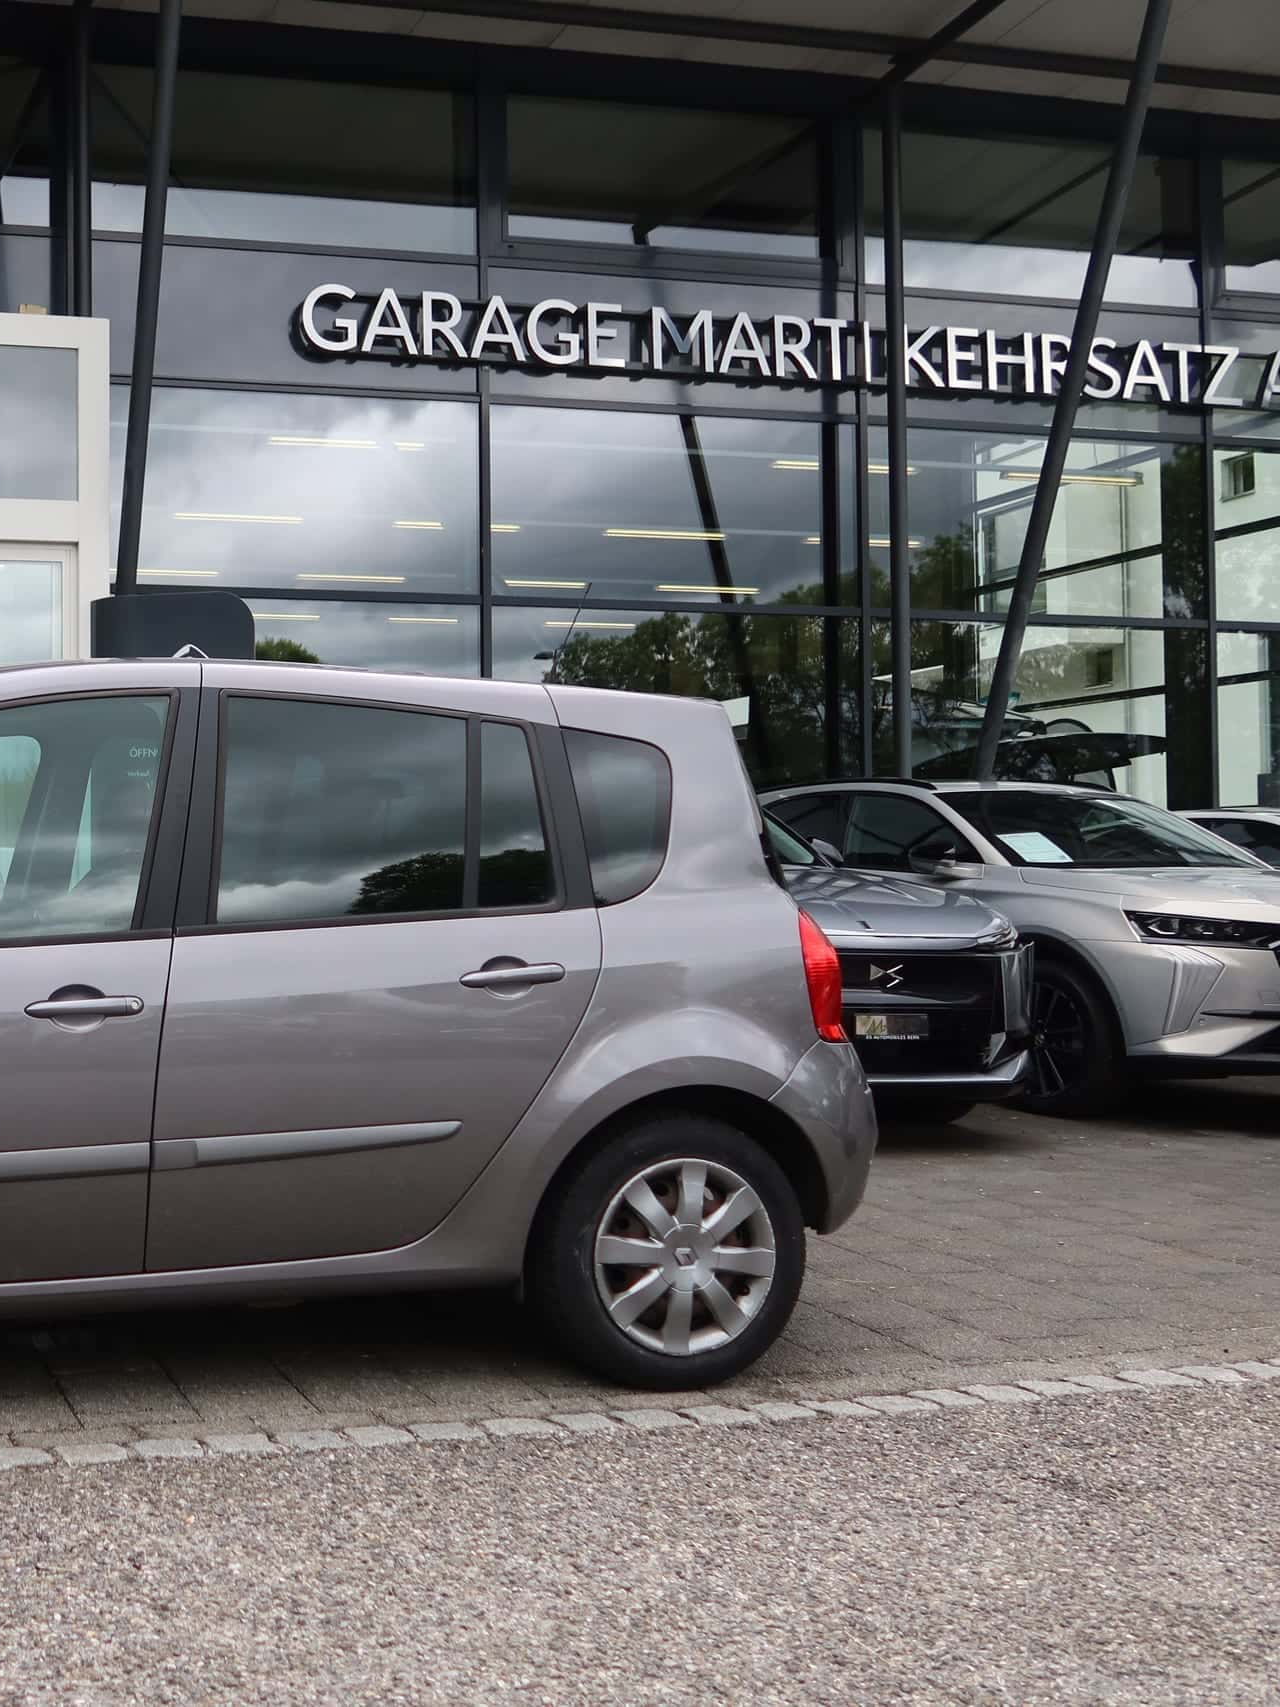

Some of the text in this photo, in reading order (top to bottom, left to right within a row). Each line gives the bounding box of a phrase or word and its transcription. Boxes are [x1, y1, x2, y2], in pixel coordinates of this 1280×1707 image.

[300, 283, 626, 369] GARAGE
[650, 305, 872, 384] MARTI
[903, 323, 1244, 407] KEHRSATZ
[128, 745, 159, 758] ÖFFN
